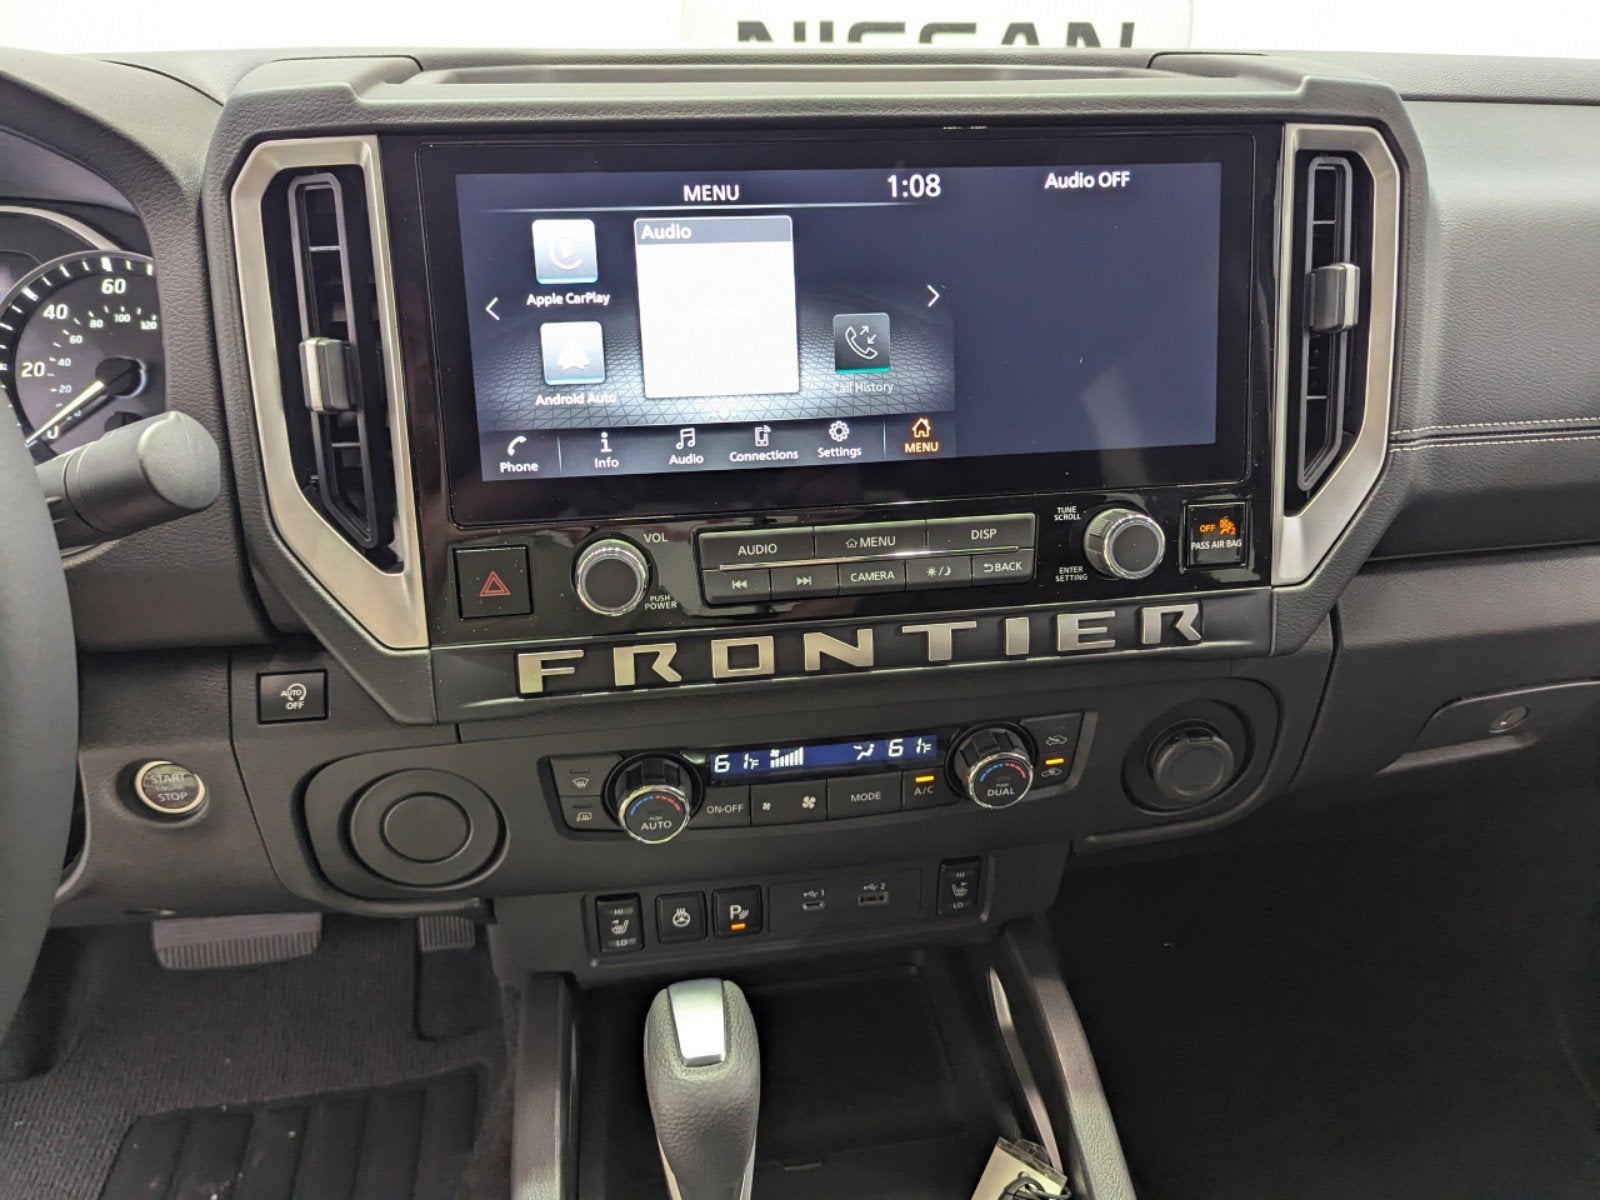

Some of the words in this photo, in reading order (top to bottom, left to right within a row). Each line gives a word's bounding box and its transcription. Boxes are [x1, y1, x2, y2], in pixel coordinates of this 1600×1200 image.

[887, 173, 942, 198] 1:08
[1044, 171, 1095, 190] Audio
[1098, 170, 1131, 188] OFF
[683, 184, 740, 202] MENU
[641, 223, 692, 241] Audio
[101, 278, 126, 295] 60
[526, 292, 563, 307] Apple
[565, 291, 611, 307] CarPlay
[43, 303, 68, 320] 40
[90, 318, 104, 329] 80
[114, 313, 131, 323] 100
[140, 320, 157, 330] 120
[69, 334, 84, 345] 60
[57, 357, 71, 368] 40
[21, 361, 45, 378] 20
[58, 384, 72, 394] 20
[855, 382, 895, 395] History
[535, 391, 586, 406] Android
[588, 391, 618, 405] Auto
[817, 444, 862, 460] Settings
[904, 440, 939, 454] MENU
[669, 452, 704, 466] Audio
[729, 448, 799, 463] Connections
[499, 459, 539, 474] Phone
[594, 456, 620, 470] Info
[1056, 505, 1077, 514] TUNE
[1054, 513, 1081, 521] SCROLL
[970, 528, 998, 541] DISP
[1199, 524, 1216, 533] OFF
[643, 532, 668, 543] VOL
[859, 535, 896, 549] MENU
[737, 543, 778, 556] AUDIO
[1190, 541, 1210, 550] PASS
[1211, 540, 1225, 550] AIR
[1226, 539, 1242, 548] BAG
[994, 560, 1023, 573] BACK
[1059, 565, 1084, 574] ENTER
[850, 570, 895, 583] CAMERA
[1055, 574, 1088, 582] SETTING
[649, 594, 671, 602] PUSH
[644, 601, 677, 610] POWER
[516, 603, 1202, 695] FRONTIER
[280, 689, 302, 698] AUTO
[286, 701, 305, 711] OFF
[150, 772, 186, 785] START
[914, 785, 934, 795] A/C
[987, 787, 1016, 797] DUAL
[158, 792, 188, 802] STOP
[851, 791, 882, 802] MODE
[706, 804, 744, 815] ON-OFF
[641, 820, 672, 831] AUTO
